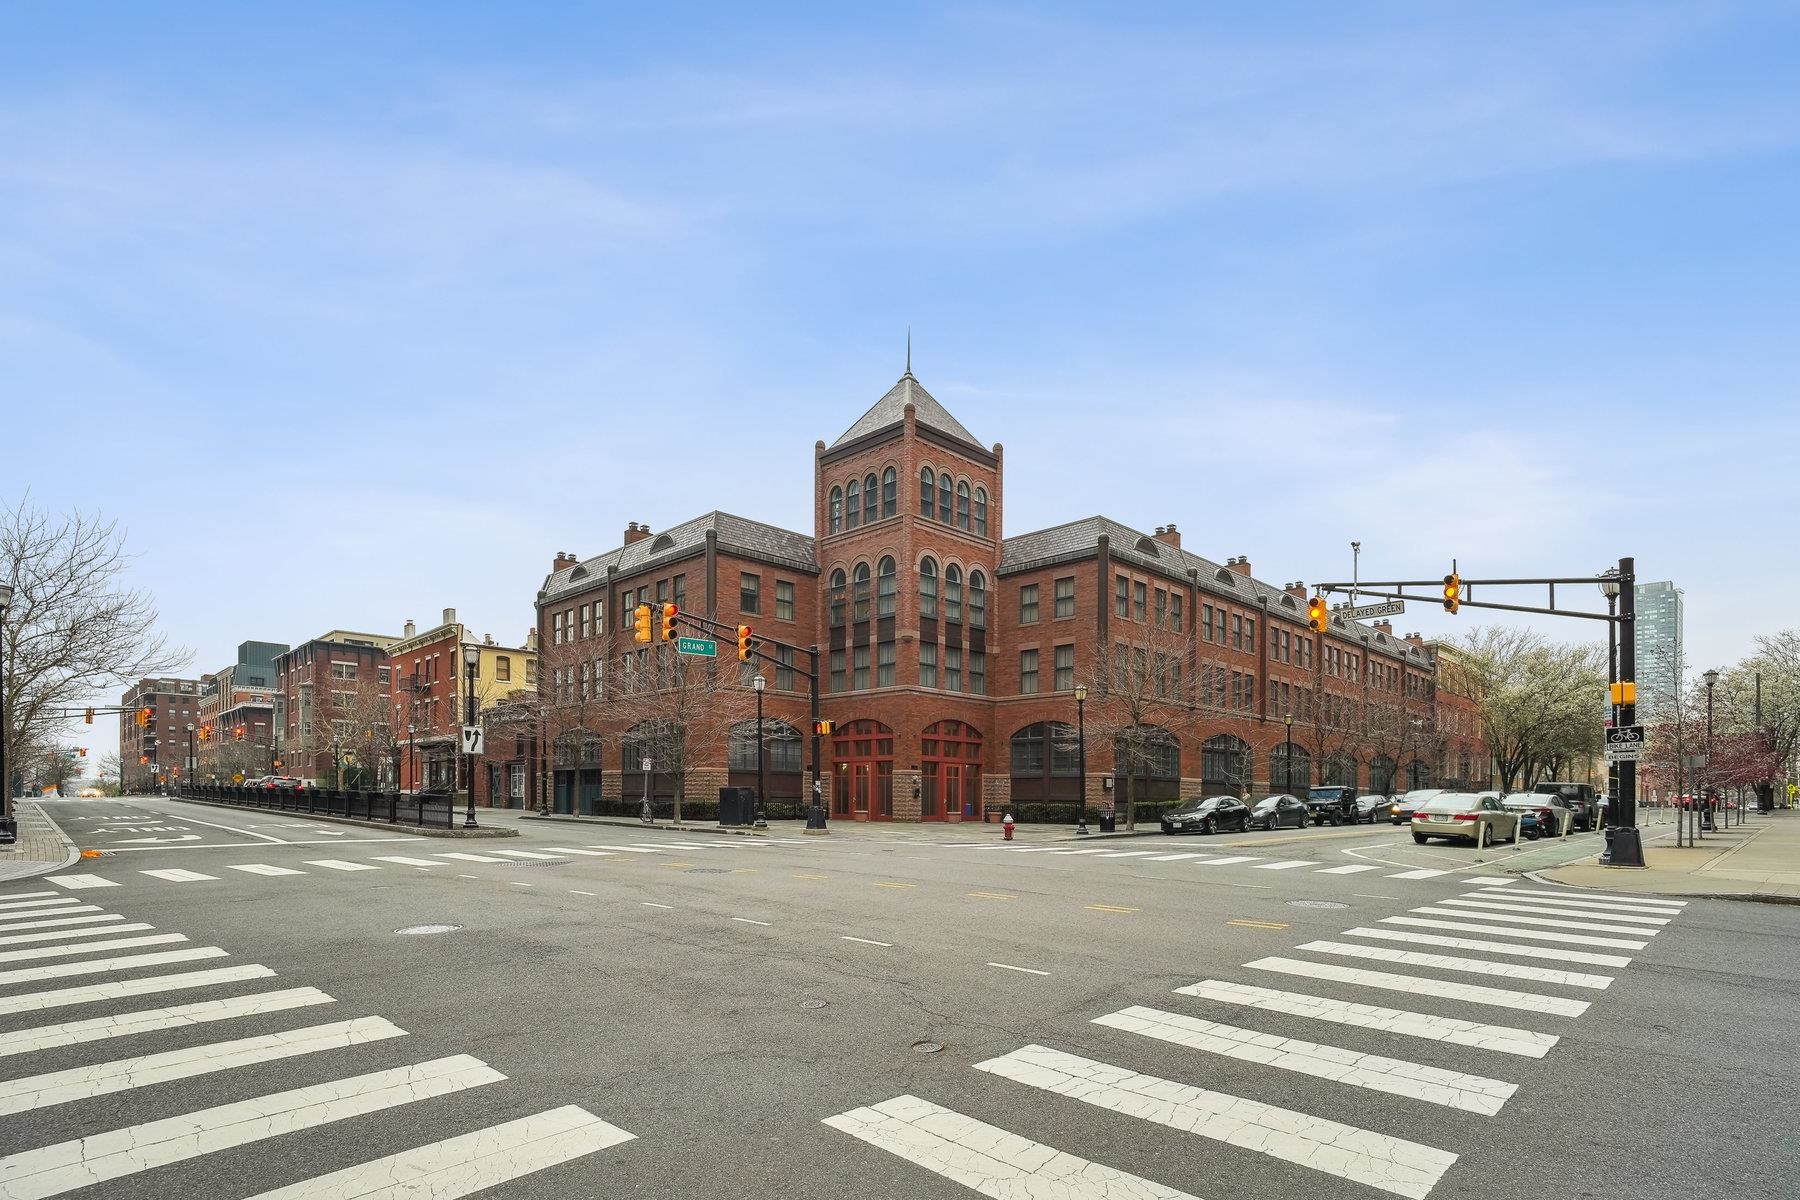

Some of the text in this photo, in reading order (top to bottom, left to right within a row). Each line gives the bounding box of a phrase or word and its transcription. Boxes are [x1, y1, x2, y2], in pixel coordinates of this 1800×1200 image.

[1342, 603, 1401, 619] DELAYED GREEN
[682, 641, 705, 651] GRAND
